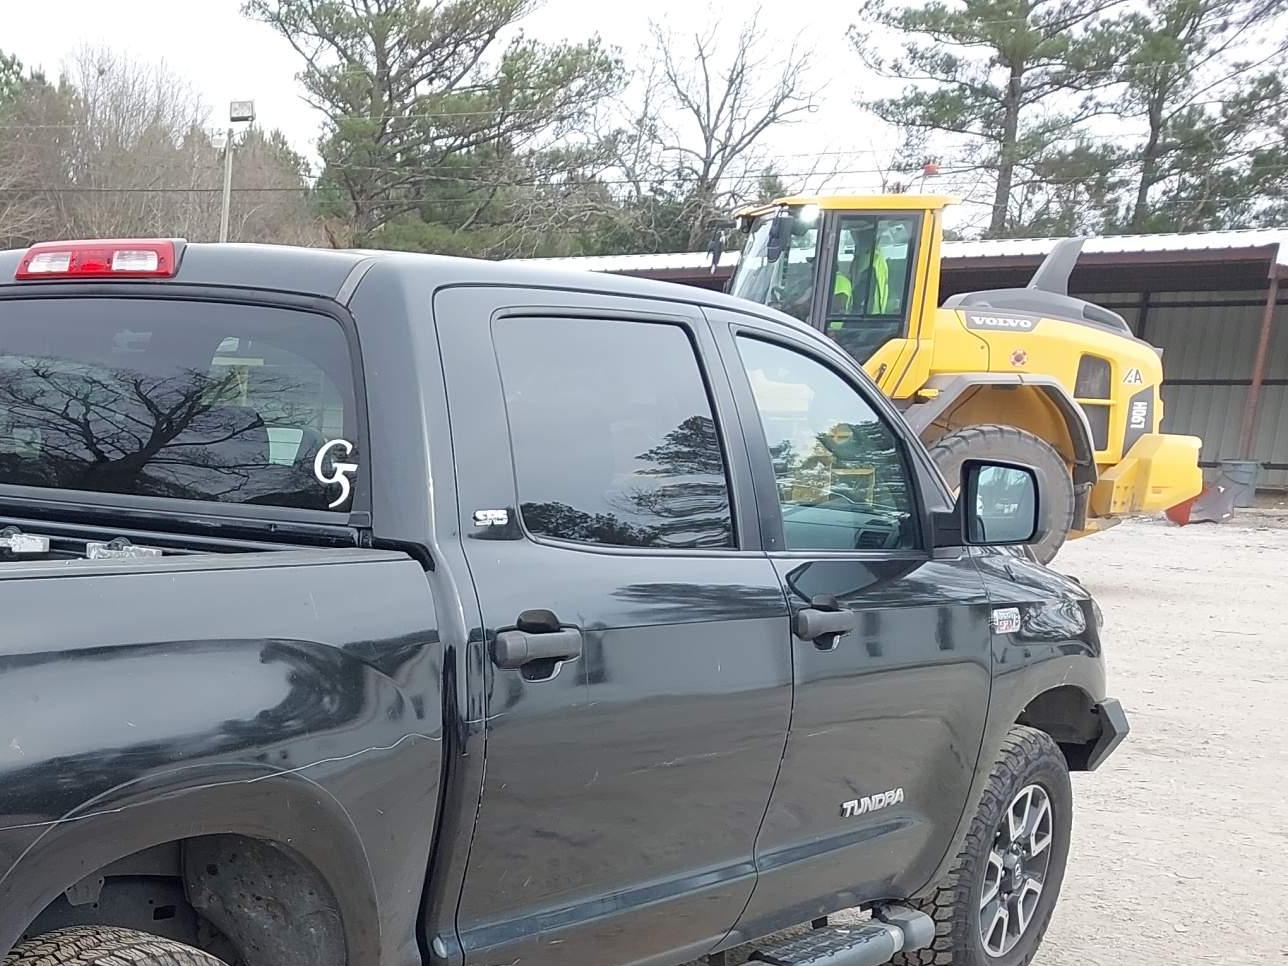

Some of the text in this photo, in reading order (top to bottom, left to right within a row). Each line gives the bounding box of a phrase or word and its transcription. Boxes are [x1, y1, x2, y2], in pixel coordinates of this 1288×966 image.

[971, 316, 1032, 328] VOLVO
[1130, 401, 1148, 429] L90H
[842, 787, 905, 818] TUNDRA
